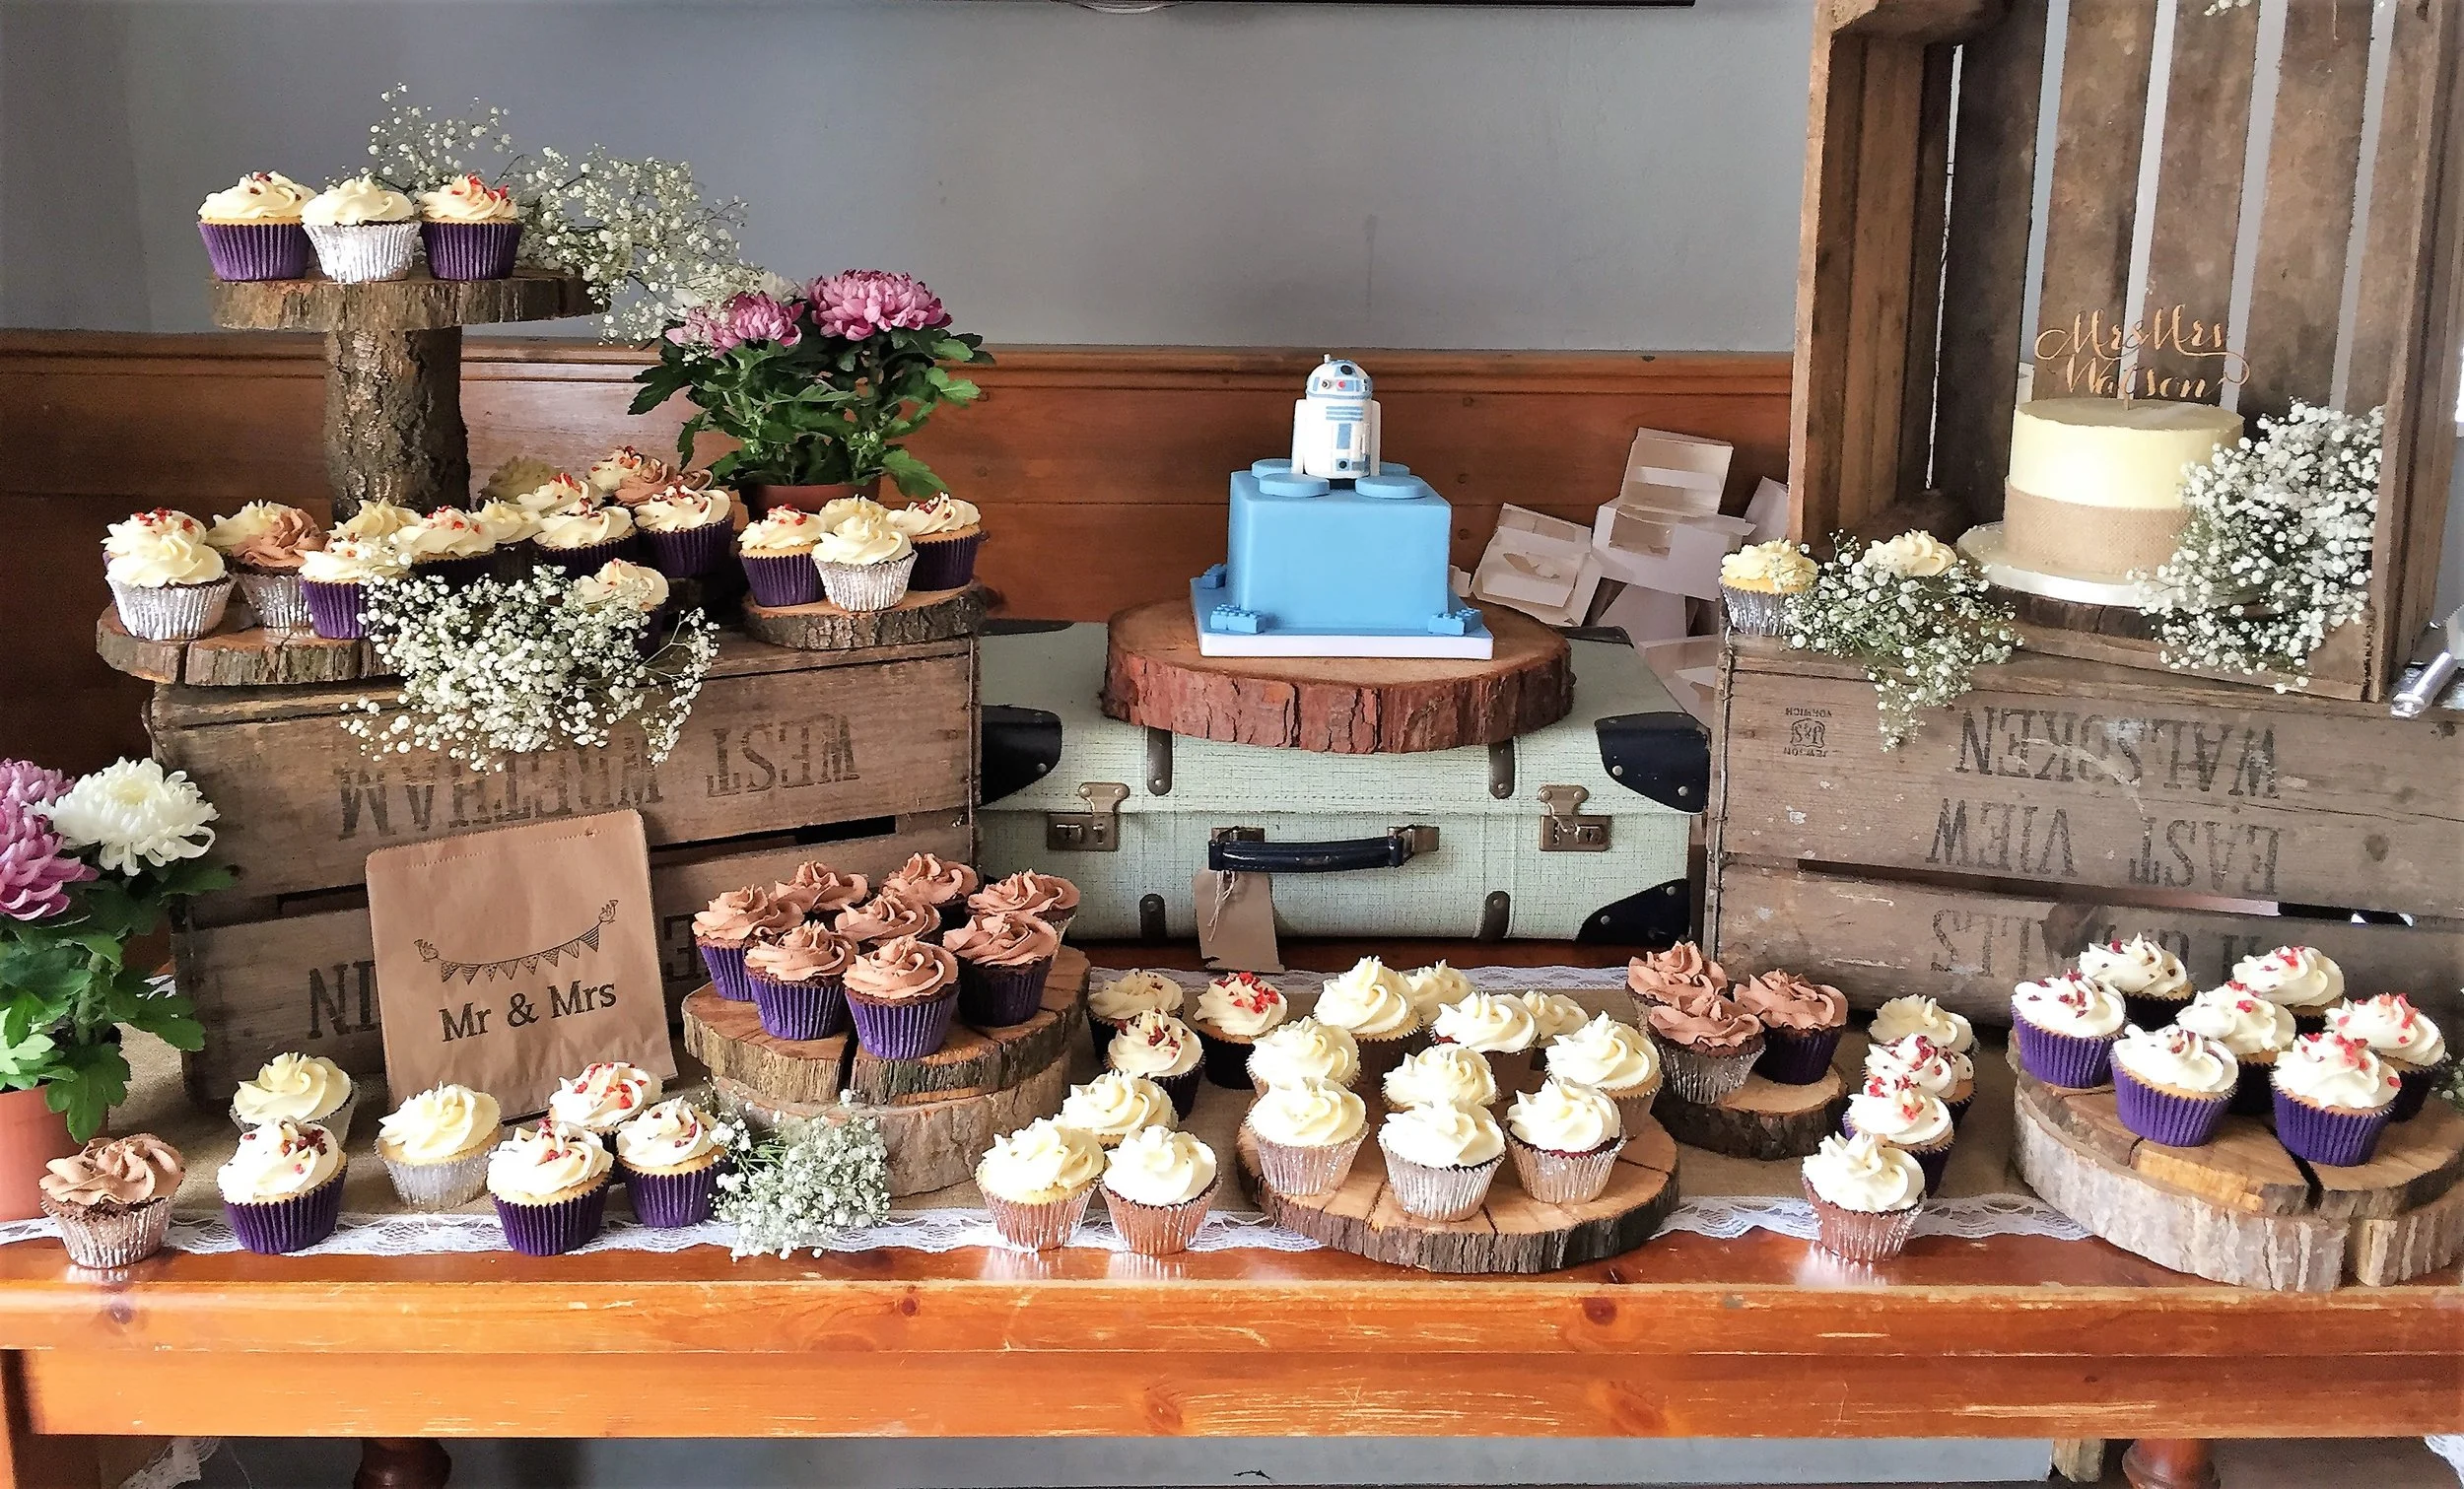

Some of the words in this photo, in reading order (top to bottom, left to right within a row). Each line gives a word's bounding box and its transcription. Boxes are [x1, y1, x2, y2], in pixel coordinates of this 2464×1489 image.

[2048, 353, 2225, 397] Watson
[706, 712, 860, 797] WEST
[1954, 706, 2281, 799] WALSOKEN
[1925, 798, 2078, 877] VIEW
[2129, 817, 2286, 896] EAST
[439, 1002, 491, 1043] Mr
[507, 992, 539, 1027] &
[547, 980, 617, 1019] Mrs
